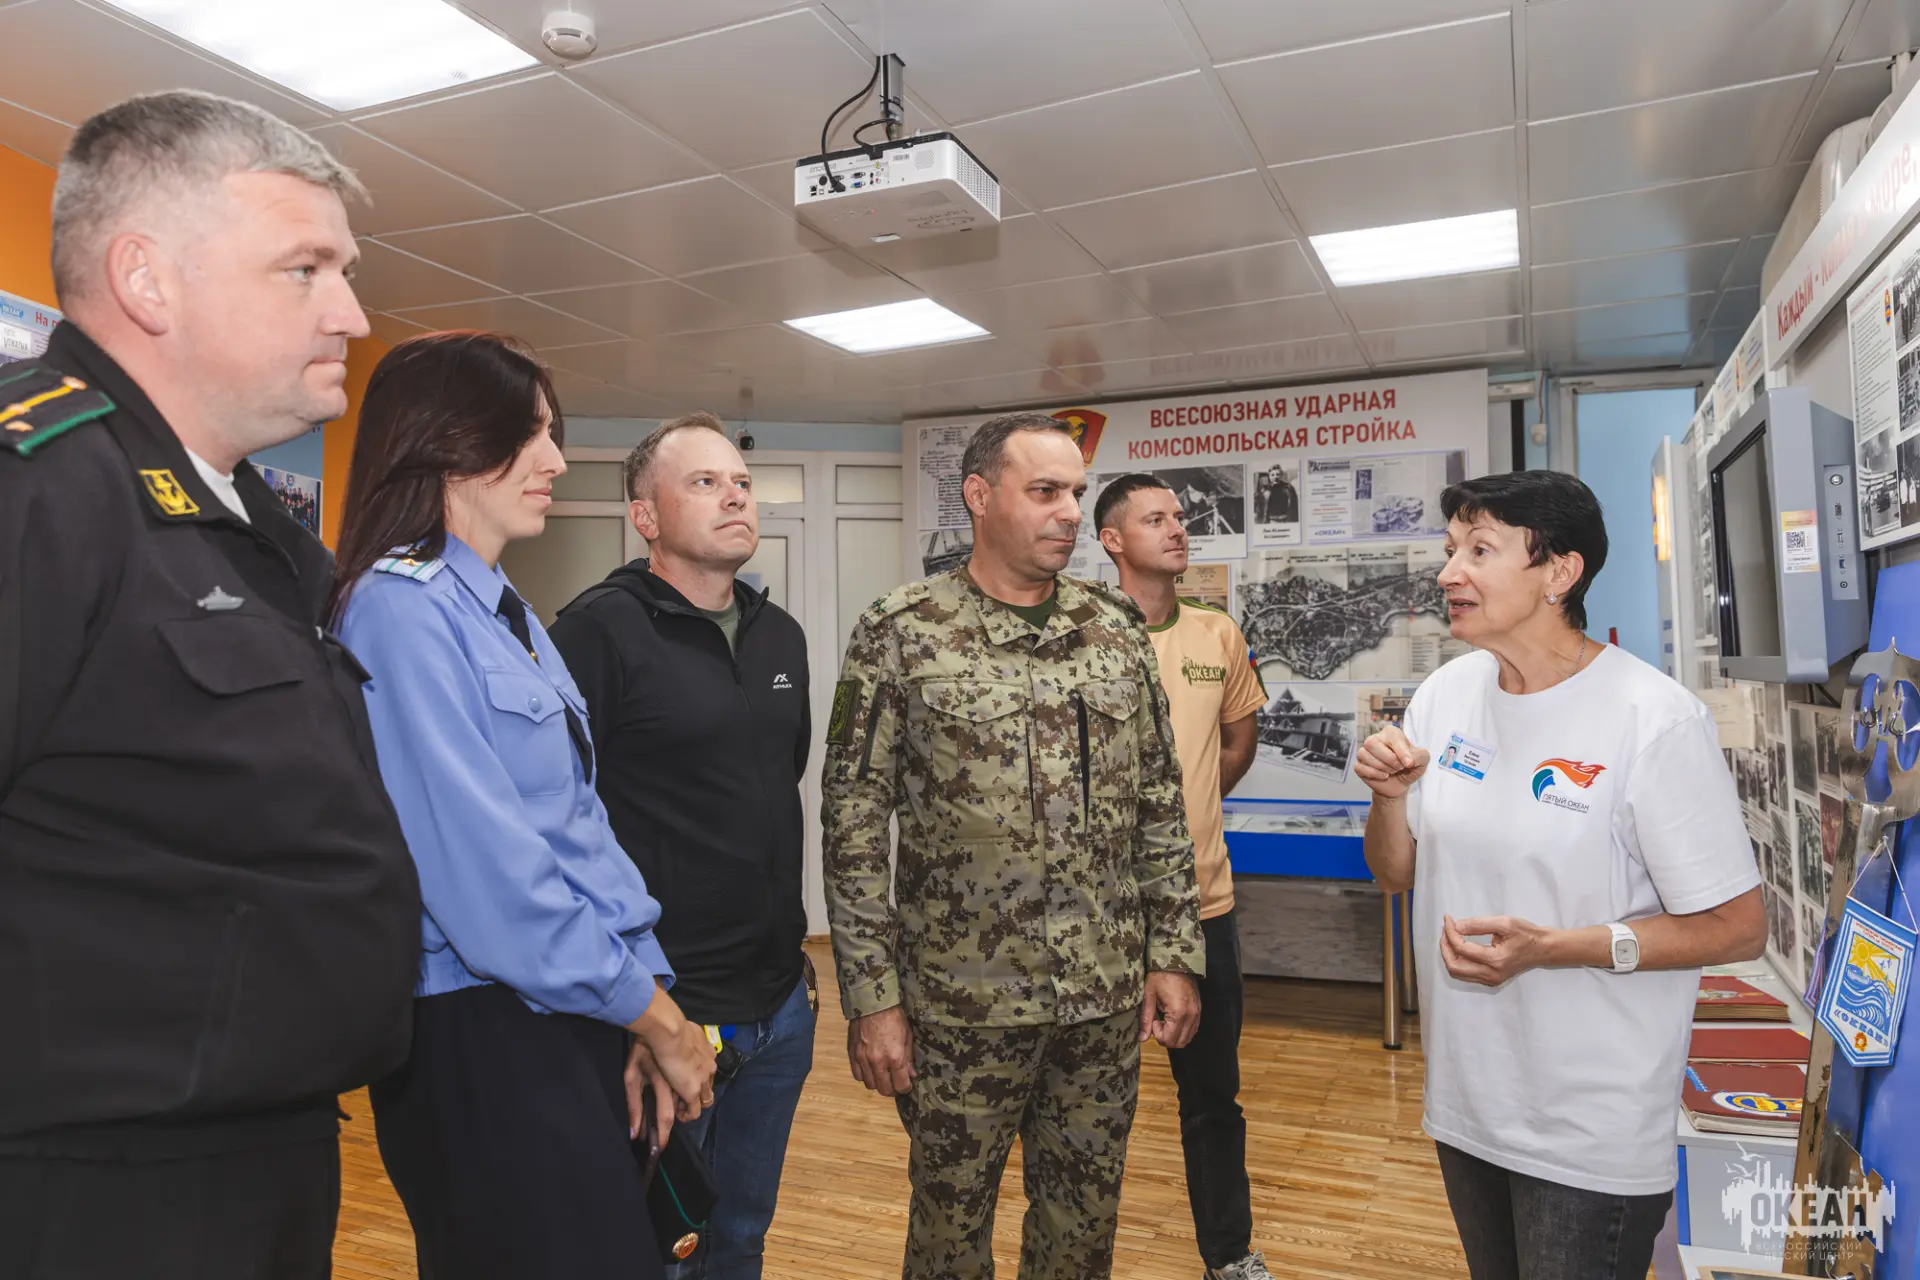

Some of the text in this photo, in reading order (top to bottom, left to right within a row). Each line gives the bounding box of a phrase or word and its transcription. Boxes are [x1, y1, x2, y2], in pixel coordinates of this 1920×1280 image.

[35, 311, 49, 327] На
[1777, 265, 1814, 341] Каждый
[1150, 388, 1396, 429] ВСЕСОЮЗНАЯ УДАРНАЯ
[1128, 417, 1417, 460] КОМСОМОЛЬСКАЯ СТРОЙКА
[1188, 667, 1221, 680] ОКЕАН
[1543, 793, 1567, 805] ПЯТЫЙ
[1567, 800, 1590, 812] ОКЕАН
[1833, 1008, 1889, 1048] «ОКЕАН»
